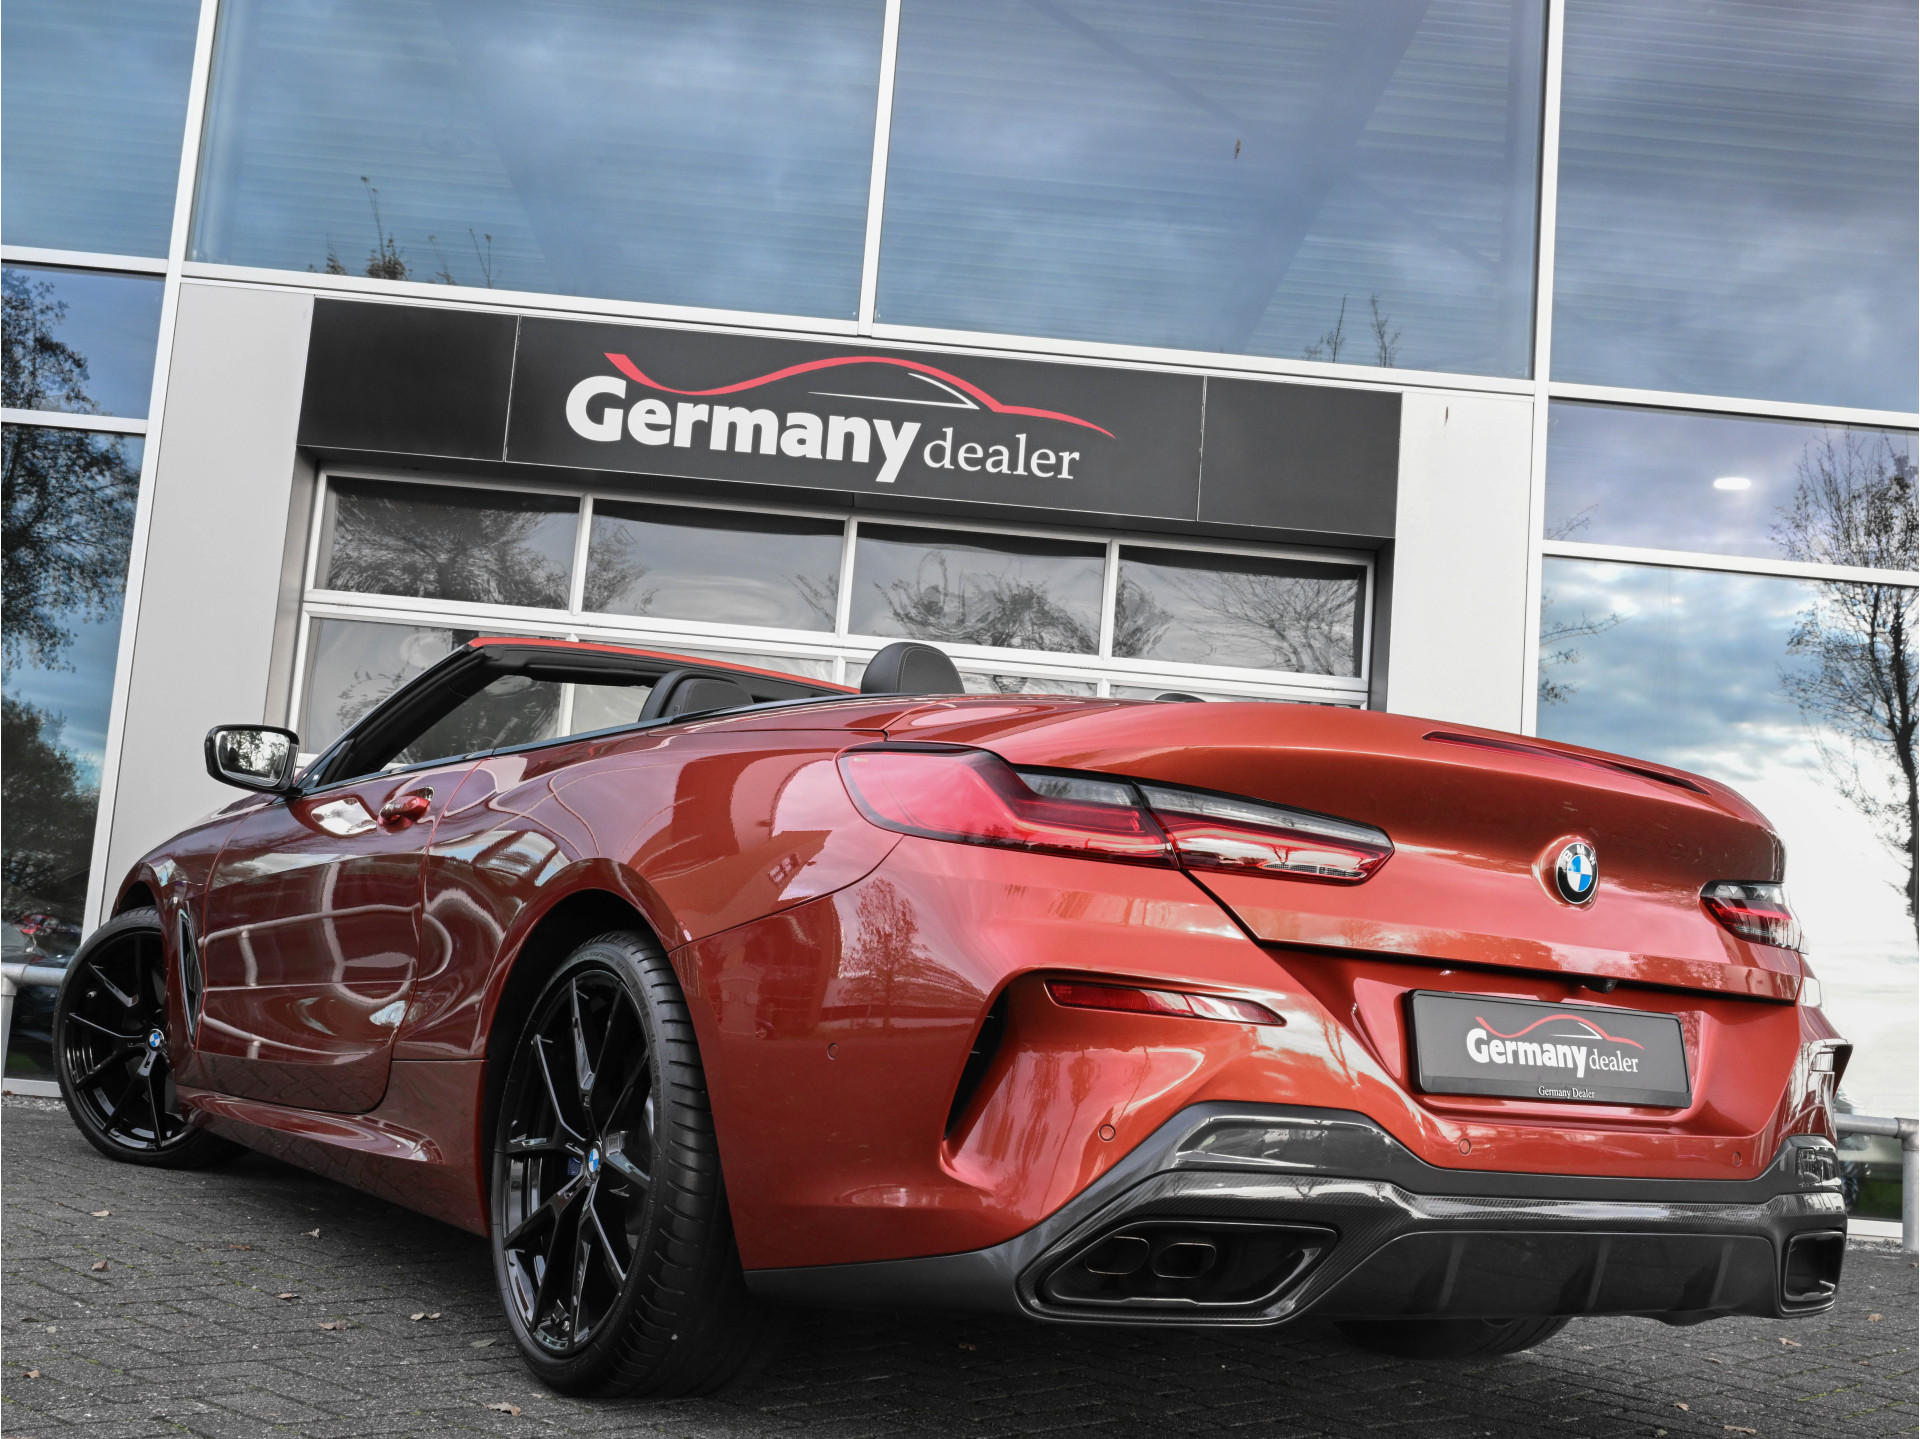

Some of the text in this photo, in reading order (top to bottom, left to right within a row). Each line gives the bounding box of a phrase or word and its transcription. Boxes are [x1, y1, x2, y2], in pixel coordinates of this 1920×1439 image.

[565, 375, 1080, 483] Germany dealer
[1563, 844, 1596, 866] BMW
[1466, 1028, 1639, 1078] Germany dealer
[1538, 1085, 1595, 1099] Germany Dealer
